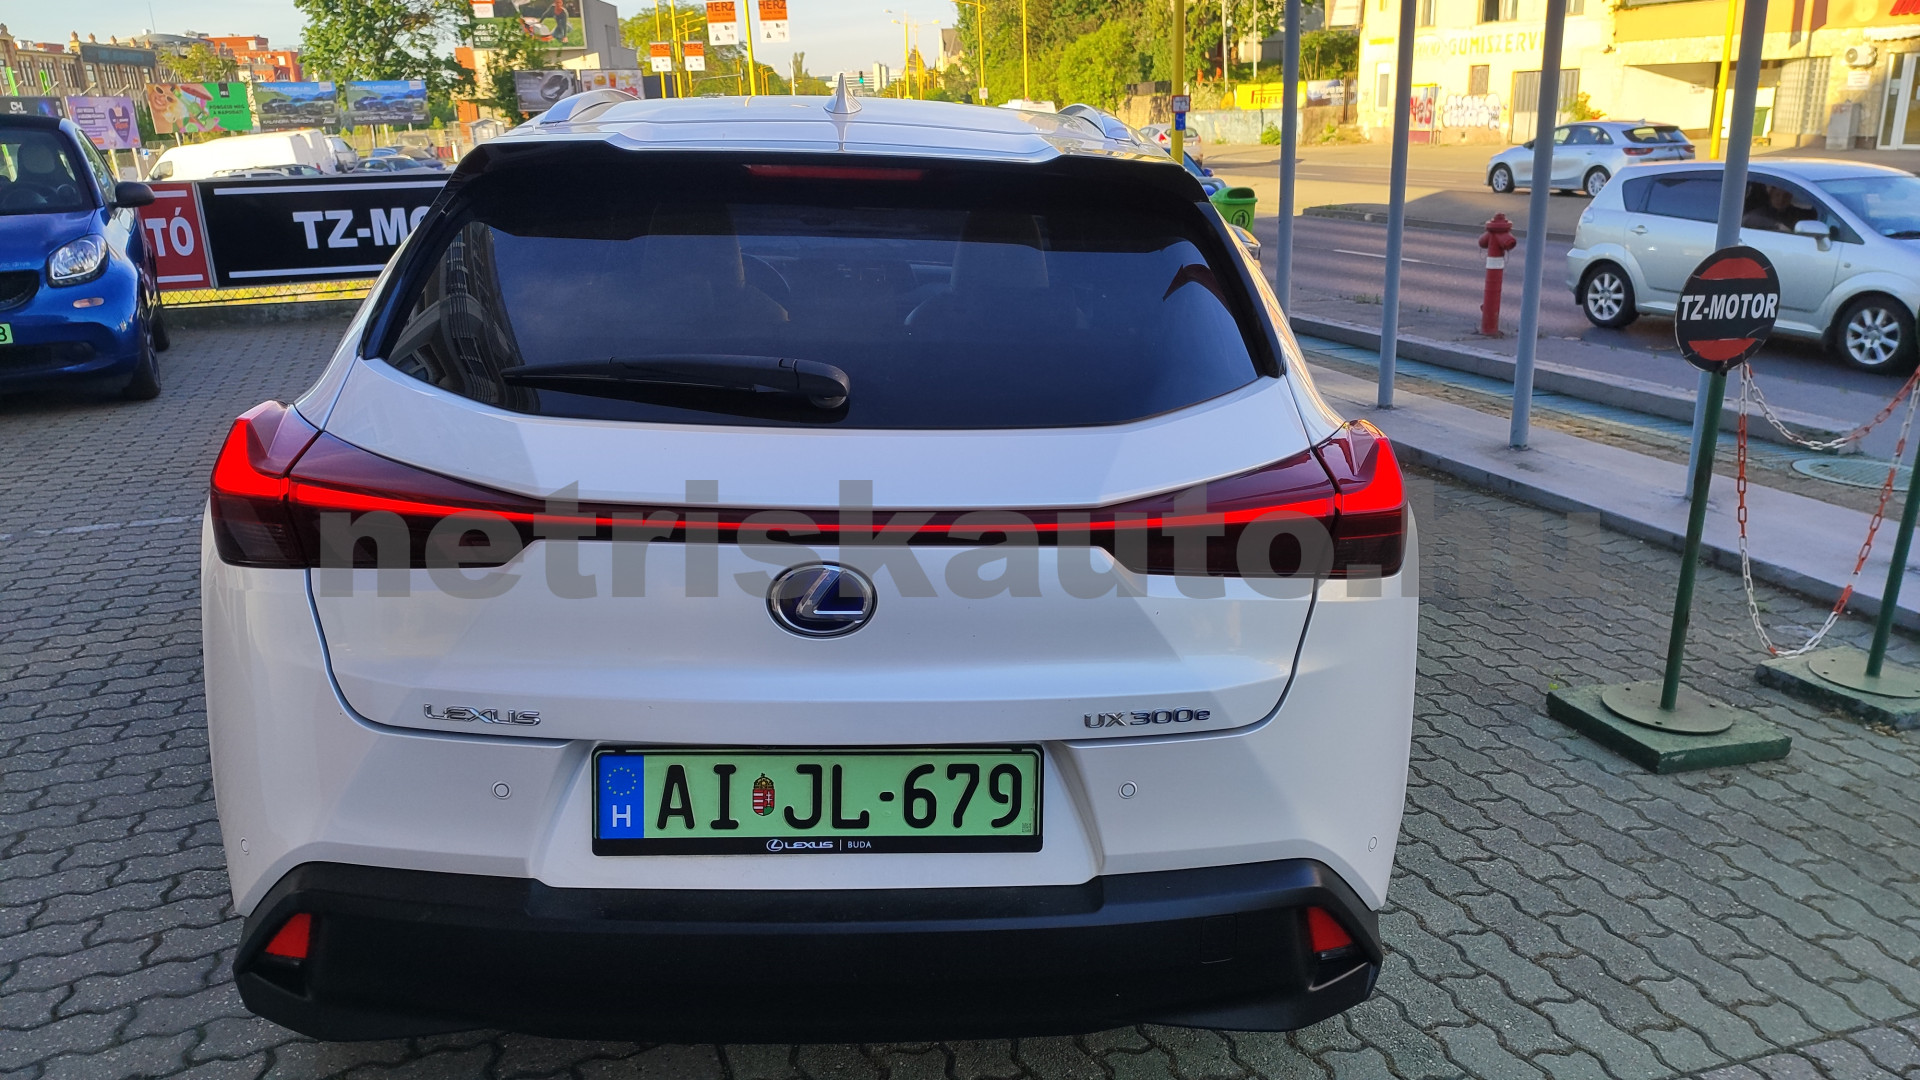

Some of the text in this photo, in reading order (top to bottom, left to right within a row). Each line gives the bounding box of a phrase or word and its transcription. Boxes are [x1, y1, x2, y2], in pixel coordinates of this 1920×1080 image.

[706, 1, 735, 12] HERZ
[759, 0, 787, 10] HERZ
[1450, 31, 1545, 56] GUMISZERVI
[1251, 89, 1284, 104] PIREL
[144, 206, 195, 257] TÓ
[1681, 293, 1778, 321] TZ-MOTOR
[423, 703, 542, 727] LEXUS
[1084, 706, 1211, 728] UX 300e
[611, 763, 1023, 830] H AI JL-679
[784, 841, 872, 849] LEXUS BUDA
